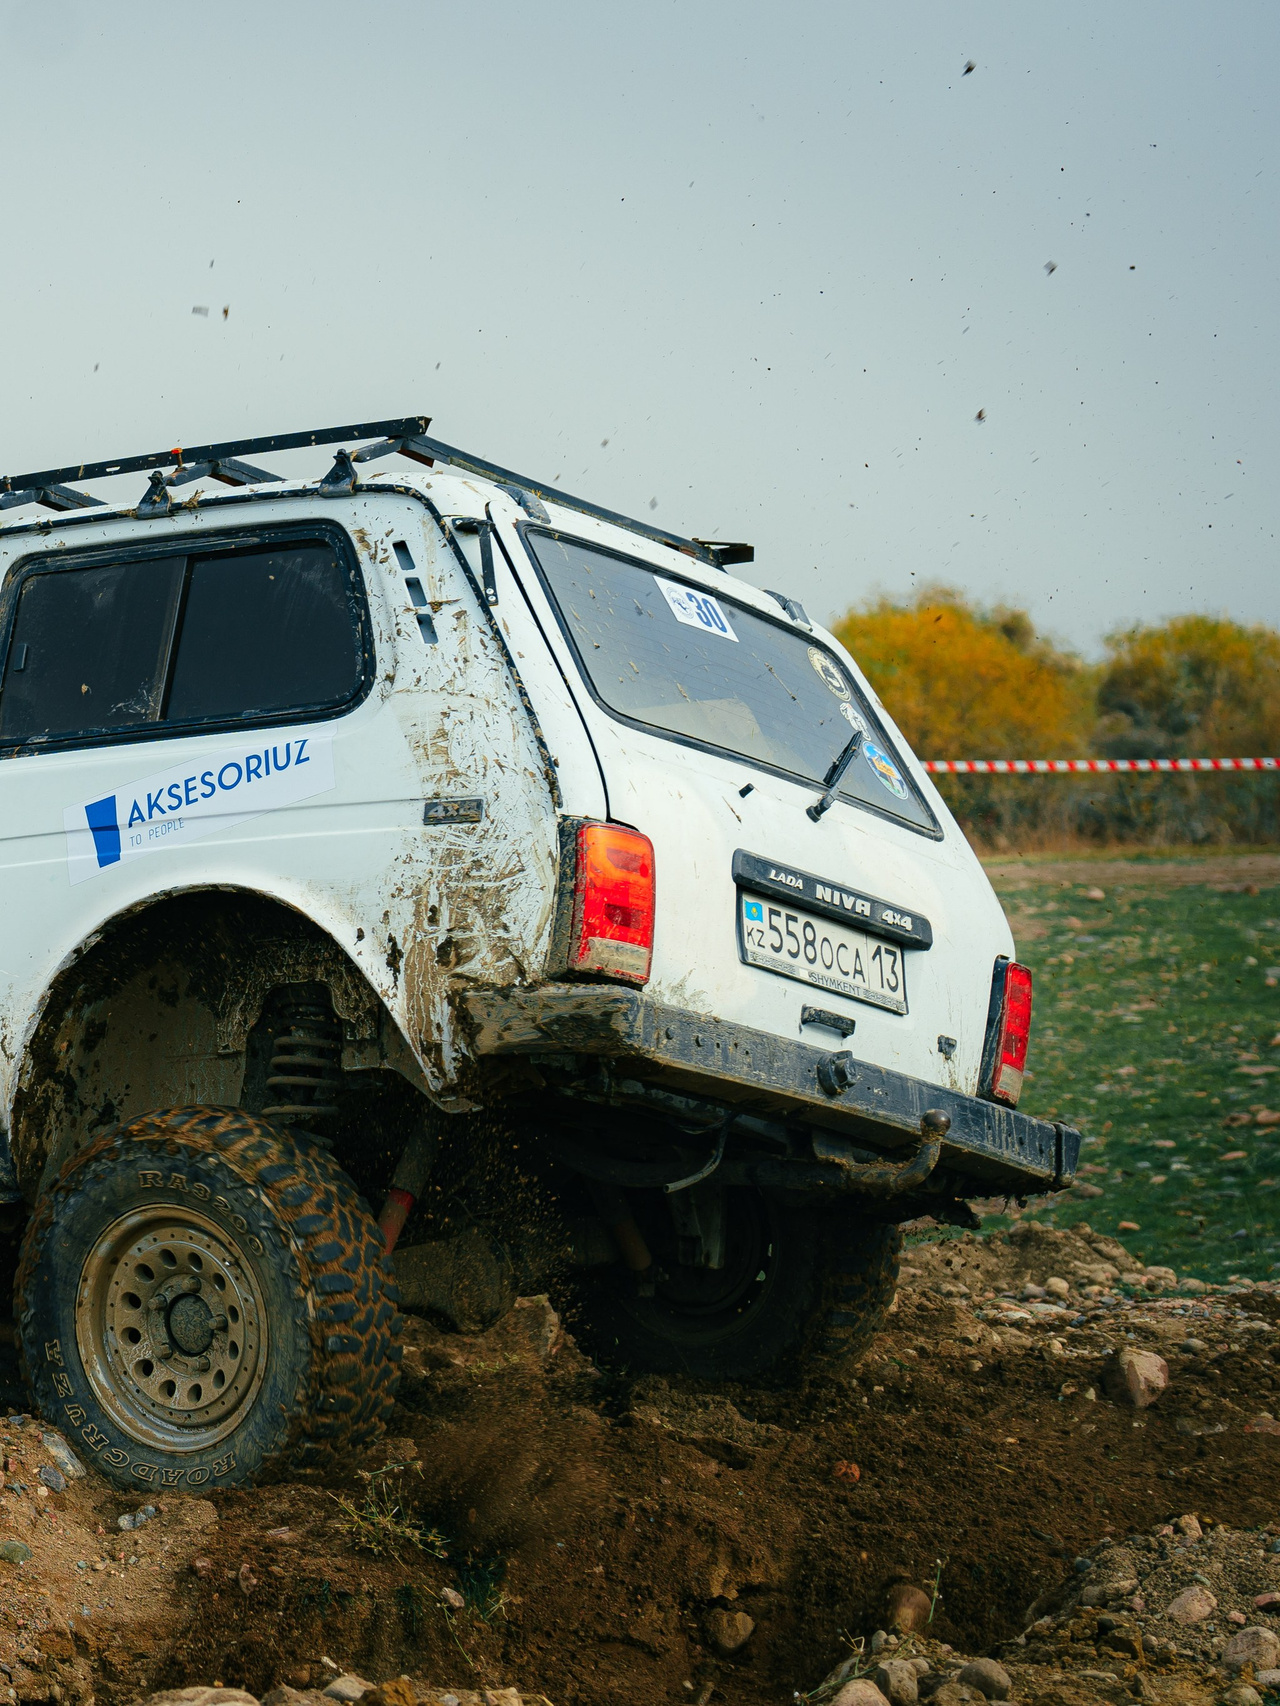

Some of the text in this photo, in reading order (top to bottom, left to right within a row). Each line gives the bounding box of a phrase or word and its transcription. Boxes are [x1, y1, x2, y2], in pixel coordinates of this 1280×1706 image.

[685, 592, 728, 633] 30
[127, 739, 311, 829] AKSESORIUZ
[129, 817, 185, 847] TO PEOPLE
[769, 869, 804, 890] LADA
[815, 883, 871, 917] NIVA
[746, 924, 766, 949] KZ
[810, 973, 863, 997] SHYMKENT
[138, 1170, 263, 1255] RA3200
[44, 1339, 237, 1487] ROADCRUZA
